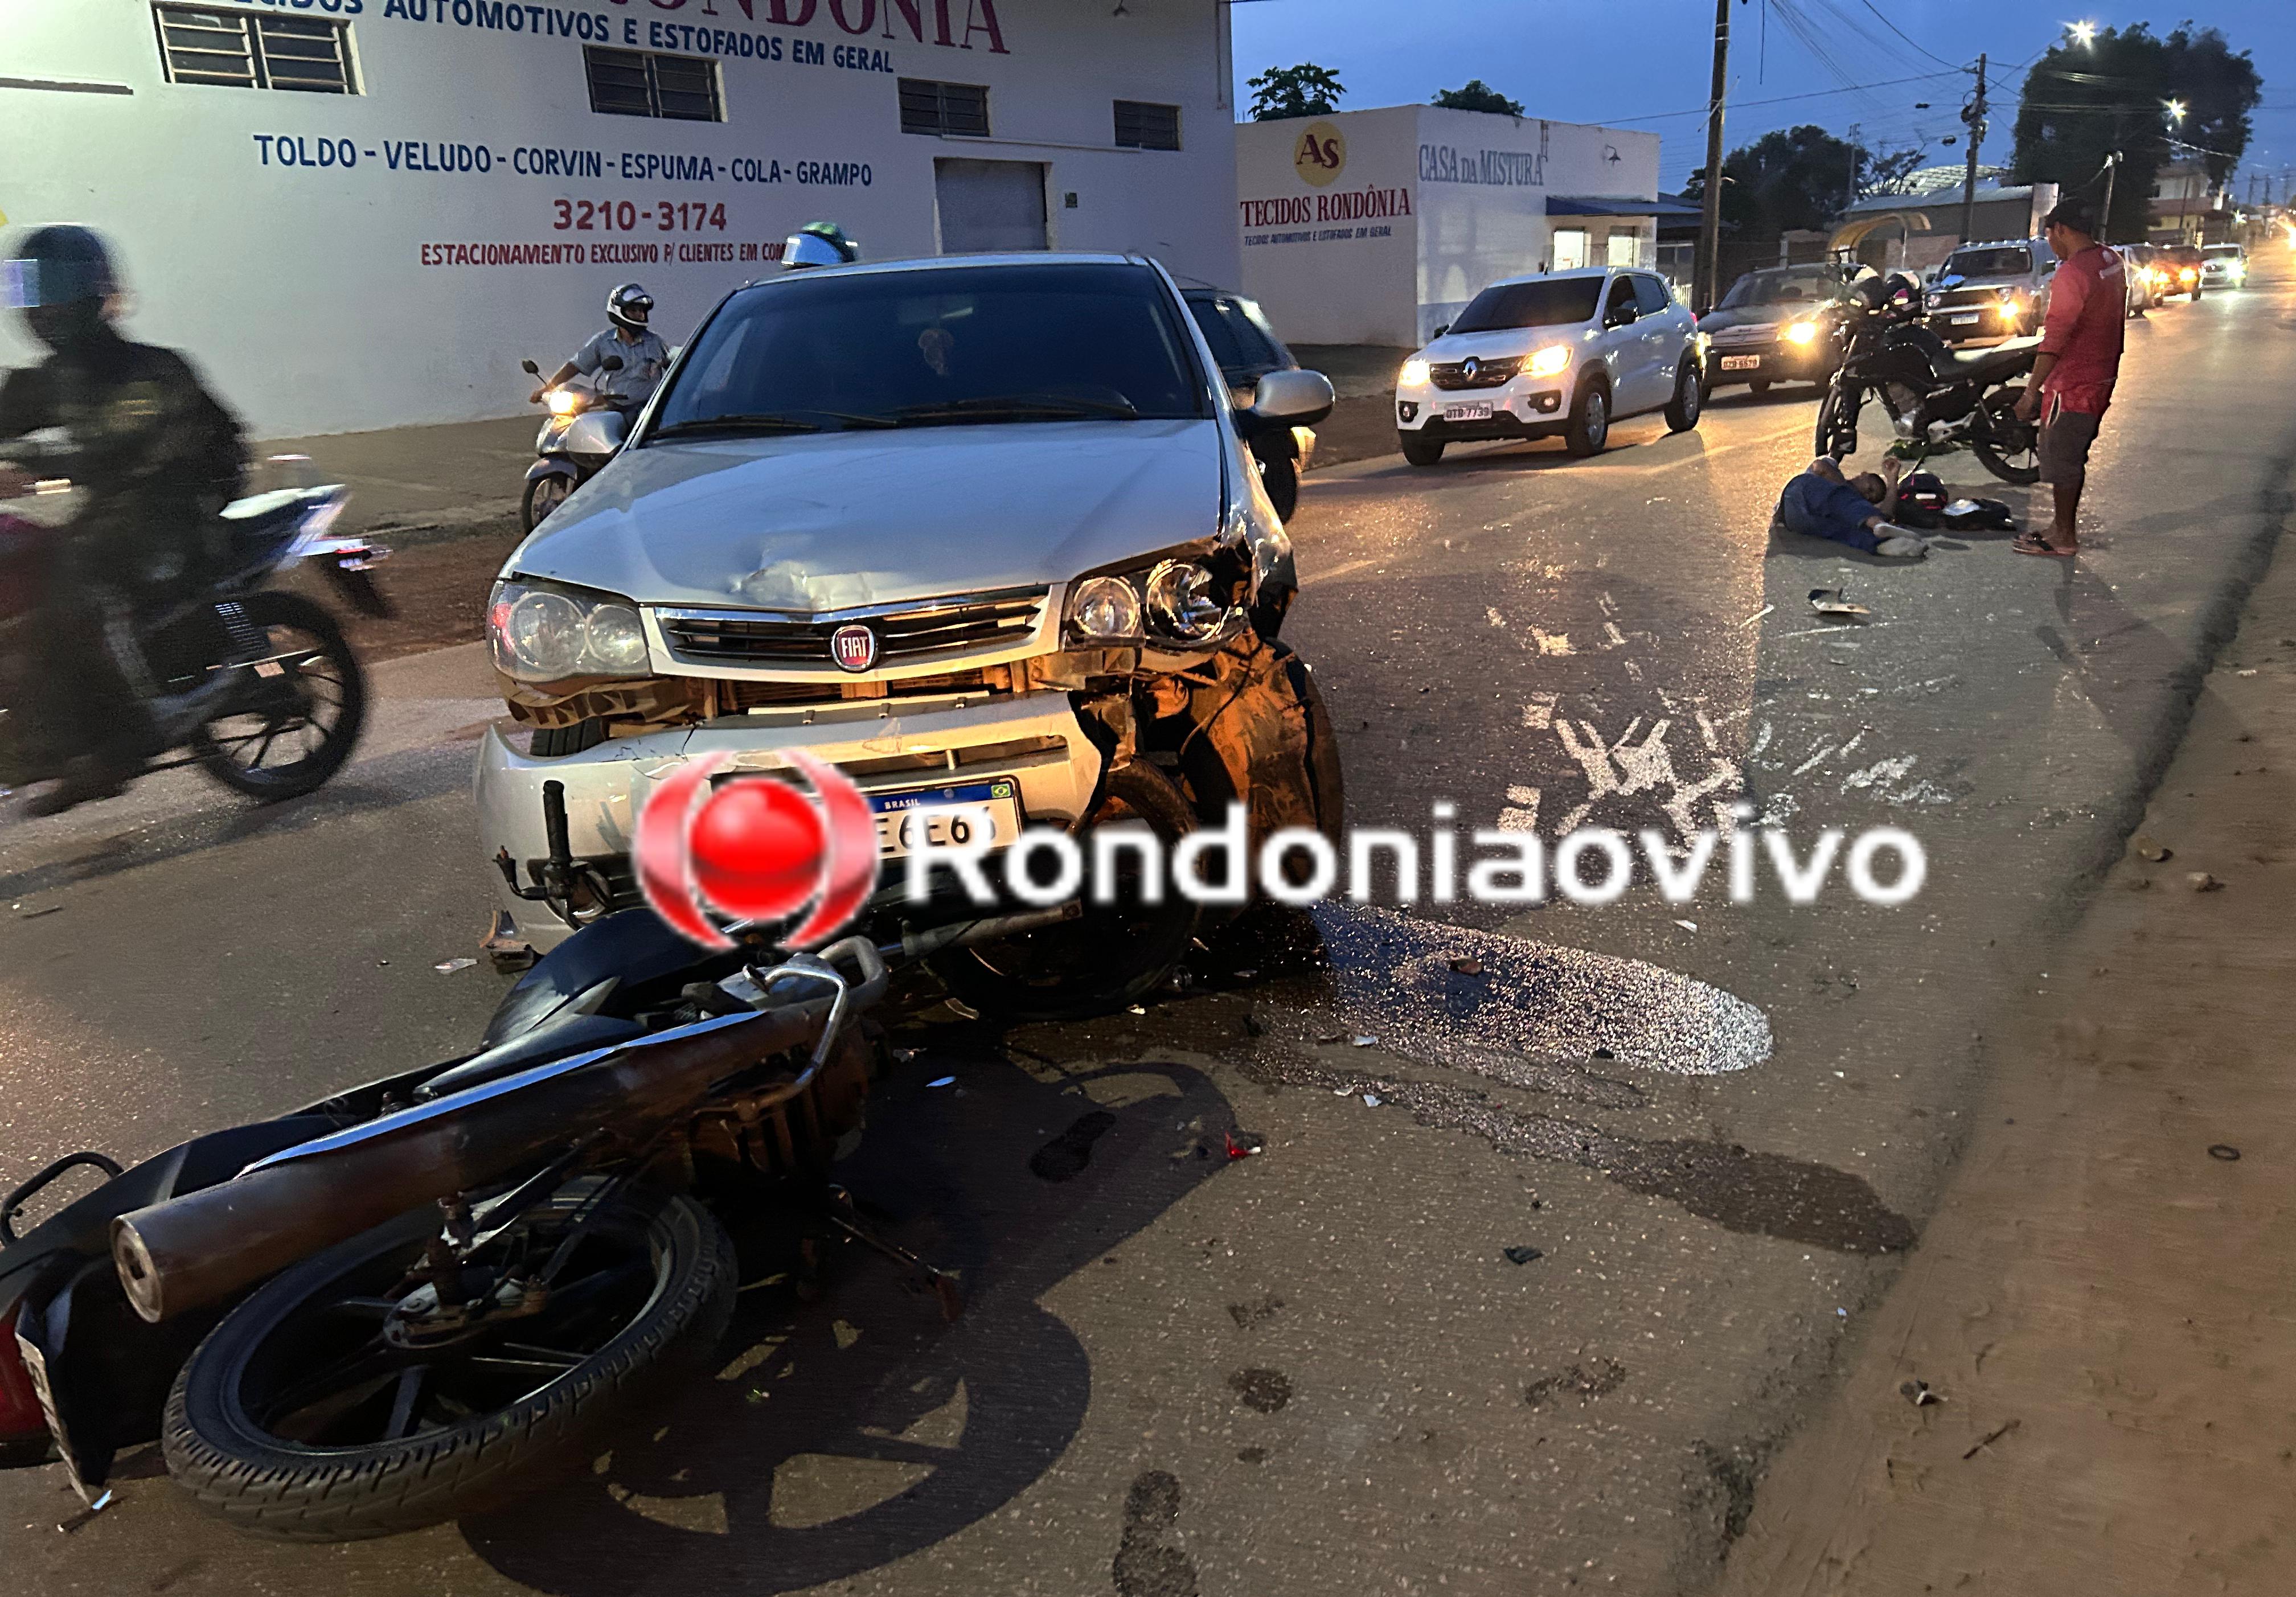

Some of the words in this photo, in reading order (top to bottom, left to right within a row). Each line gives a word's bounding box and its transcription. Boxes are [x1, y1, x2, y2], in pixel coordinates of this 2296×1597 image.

[383, 0, 609, 41] AUTOMOTIVOS
[624, 18, 638, 44] E
[649, 21, 782, 60] ESTOFADOS
[792, 39, 825, 65] EM
[833, 46, 894, 73] GERAL
[1296, 134, 1339, 169] AS
[1418, 145, 1459, 182] CASA
[1460, 158, 1479, 183] DA
[1480, 150, 1544, 186] MISTURA
[554, 199, 727, 231] 3210-3174
[1240, 196, 1311, 227] TECIDOS
[1317, 184, 1411, 221] RONDÔNIA
[1244, 235, 1270, 246] TECIDOS
[1270, 232, 1311, 244] AUTOMOTIVOS
[1319, 228, 1353, 241] ESTOFADOS
[1356, 227, 1367, 238] EM
[1370, 225, 1391, 237] GERAL
[421, 244, 584, 266] ESTACIONAMENTO
[591, 244, 658, 264] EXCLUSIVO
[679, 244, 733, 262] CLIENTES
[740, 244, 758, 261] EM
[841, 635, 869, 659] FIAT
[884, 798, 921, 811] BRASIL
